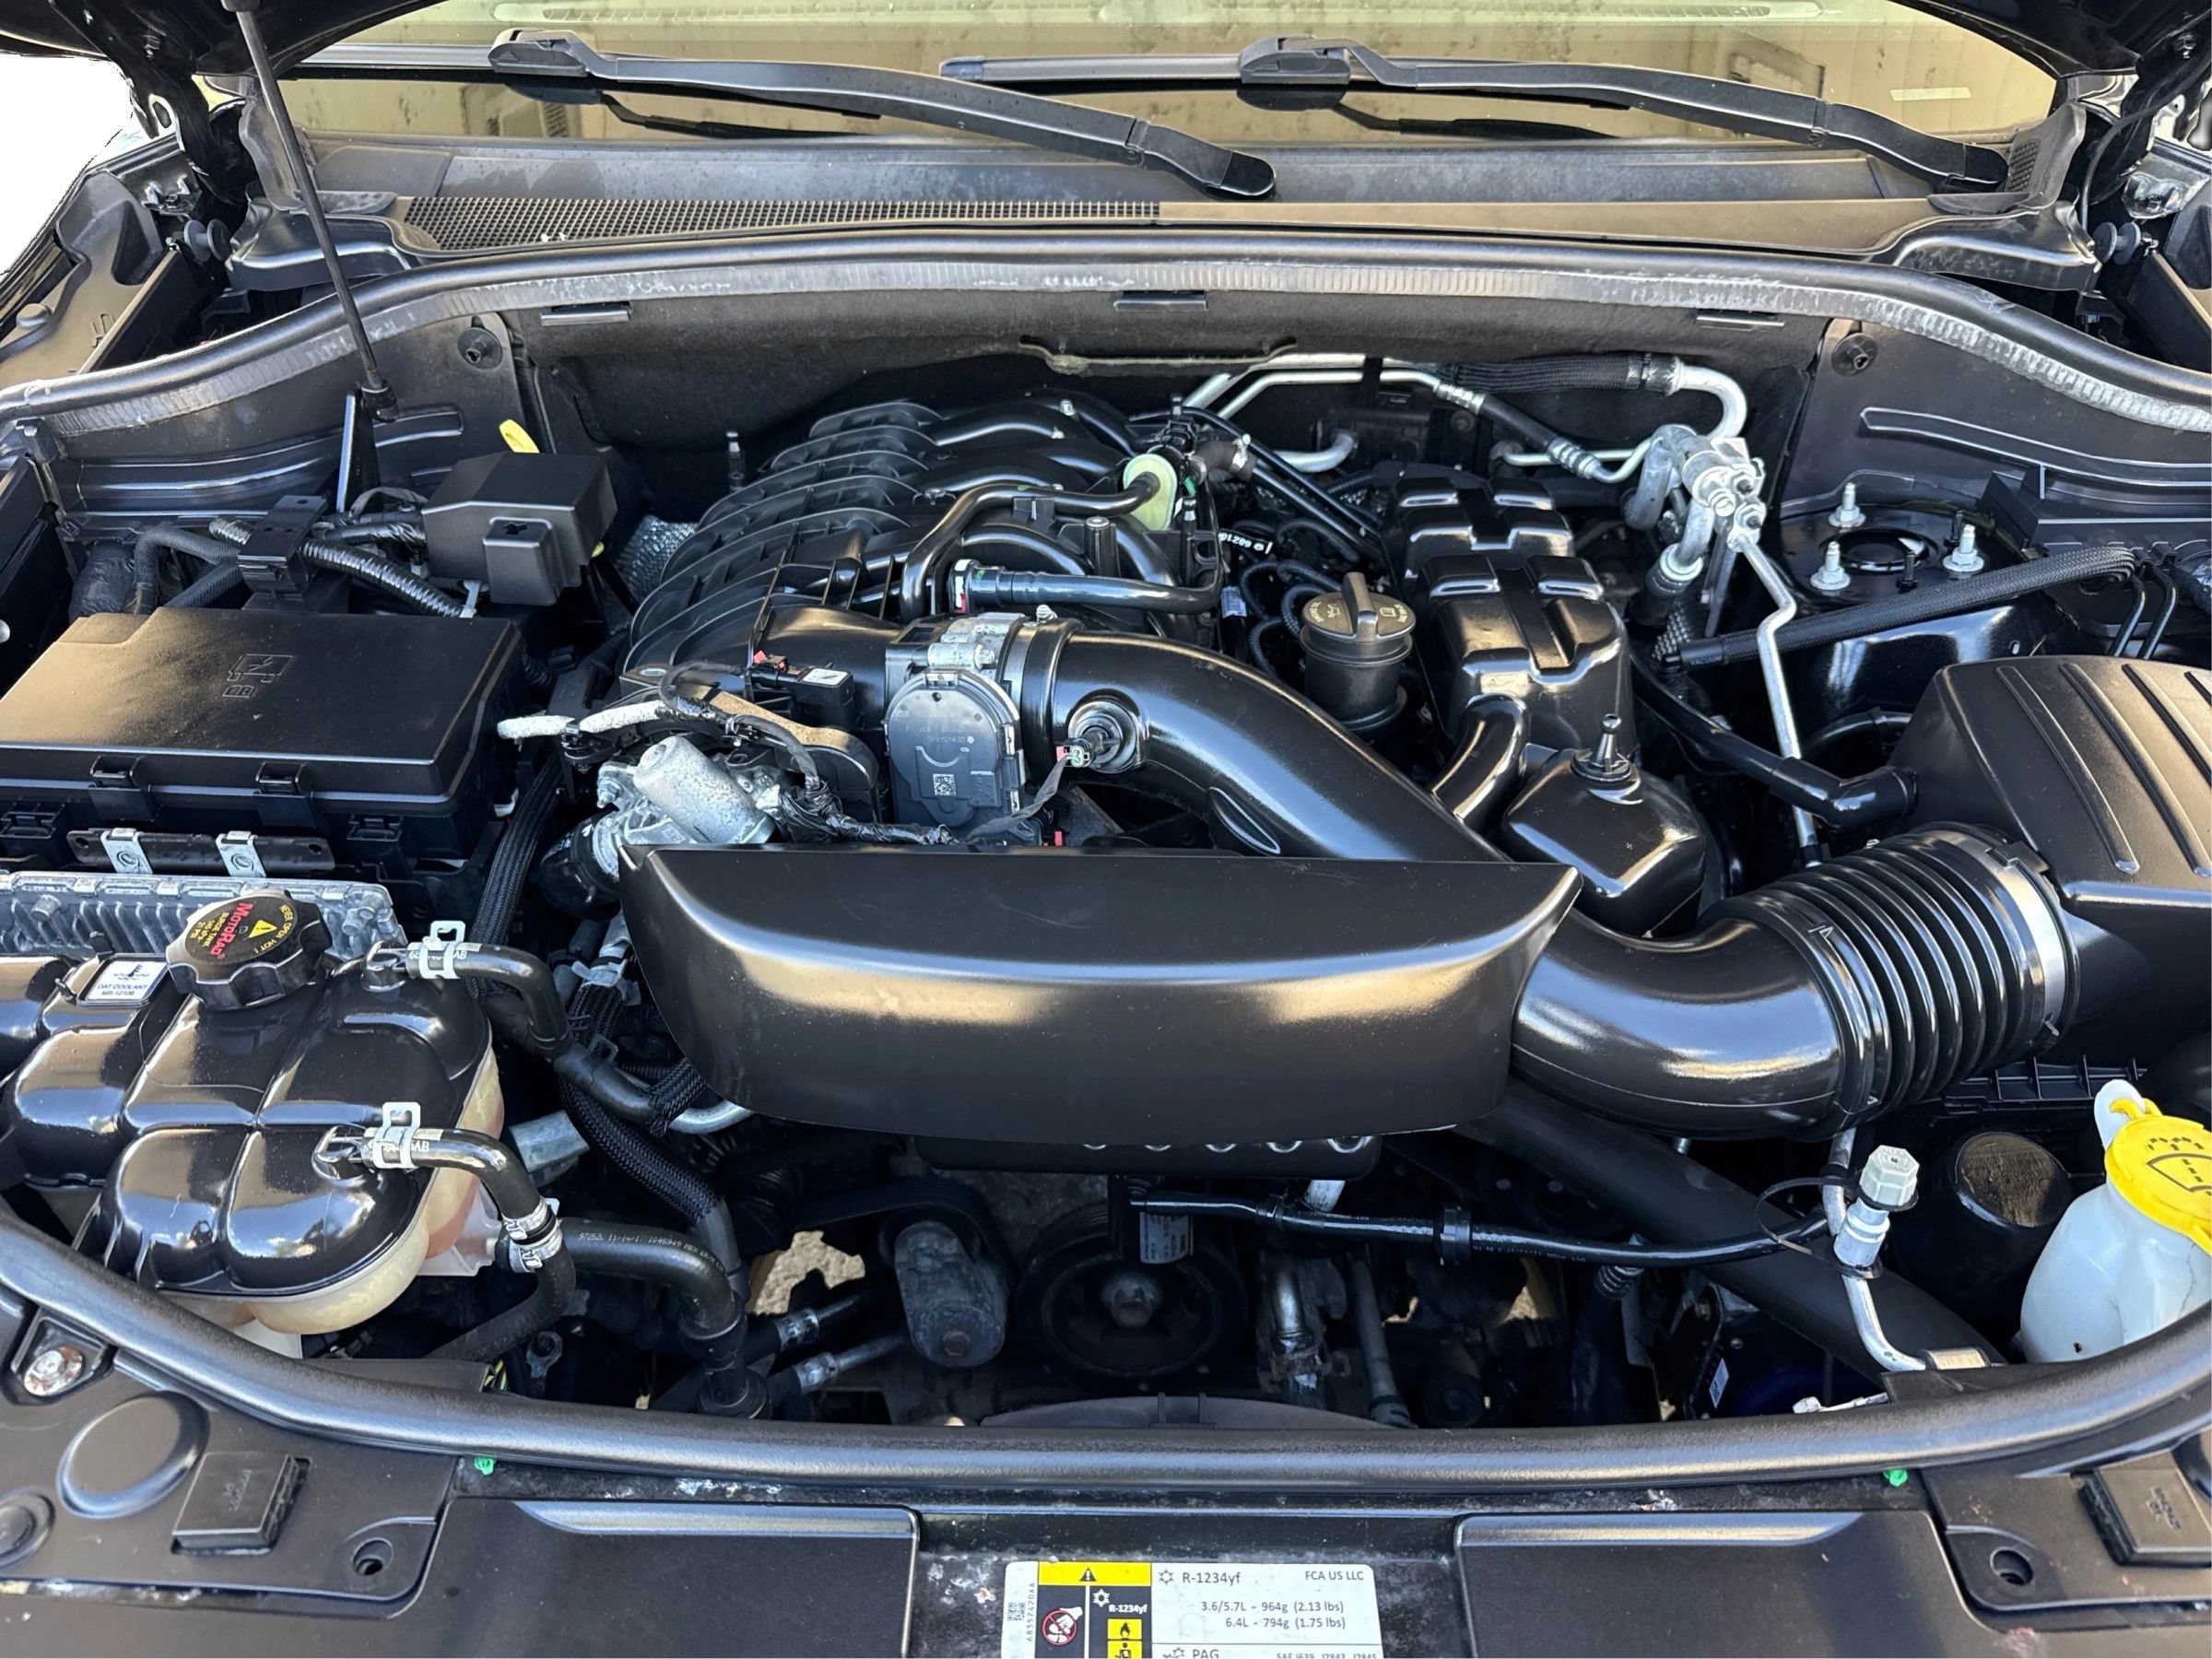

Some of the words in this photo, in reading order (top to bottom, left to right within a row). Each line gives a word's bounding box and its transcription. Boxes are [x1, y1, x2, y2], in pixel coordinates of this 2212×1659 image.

[276, 923, 292, 938] OPEN
[261, 938, 277, 951] HOT
[1182, 1571, 1241, 1586] R-1234yf
[1305, 1571, 1325, 1581] FCA
[1328, 1571, 1343, 1581] US
[1346, 1571, 1364, 1581] LLC
[1109, 1604, 1147, 1614] R-1234yf
[1201, 1600, 1246, 1613] 3.6/5.7L
[1262, 1602, 1288, 1614] 964g
[1294, 1601, 1321, 1614] (2.13
[1324, 1601, 1344, 1614] lbs)
[1226, 1618, 1248, 1628] 6.4L
[1263, 1618, 1289, 1630] 794g
[1295, 1617, 1323, 1630] (1.75
[1325, 1617, 1346, 1630] lbs)
[1193, 1649, 1219, 1659] PAG
